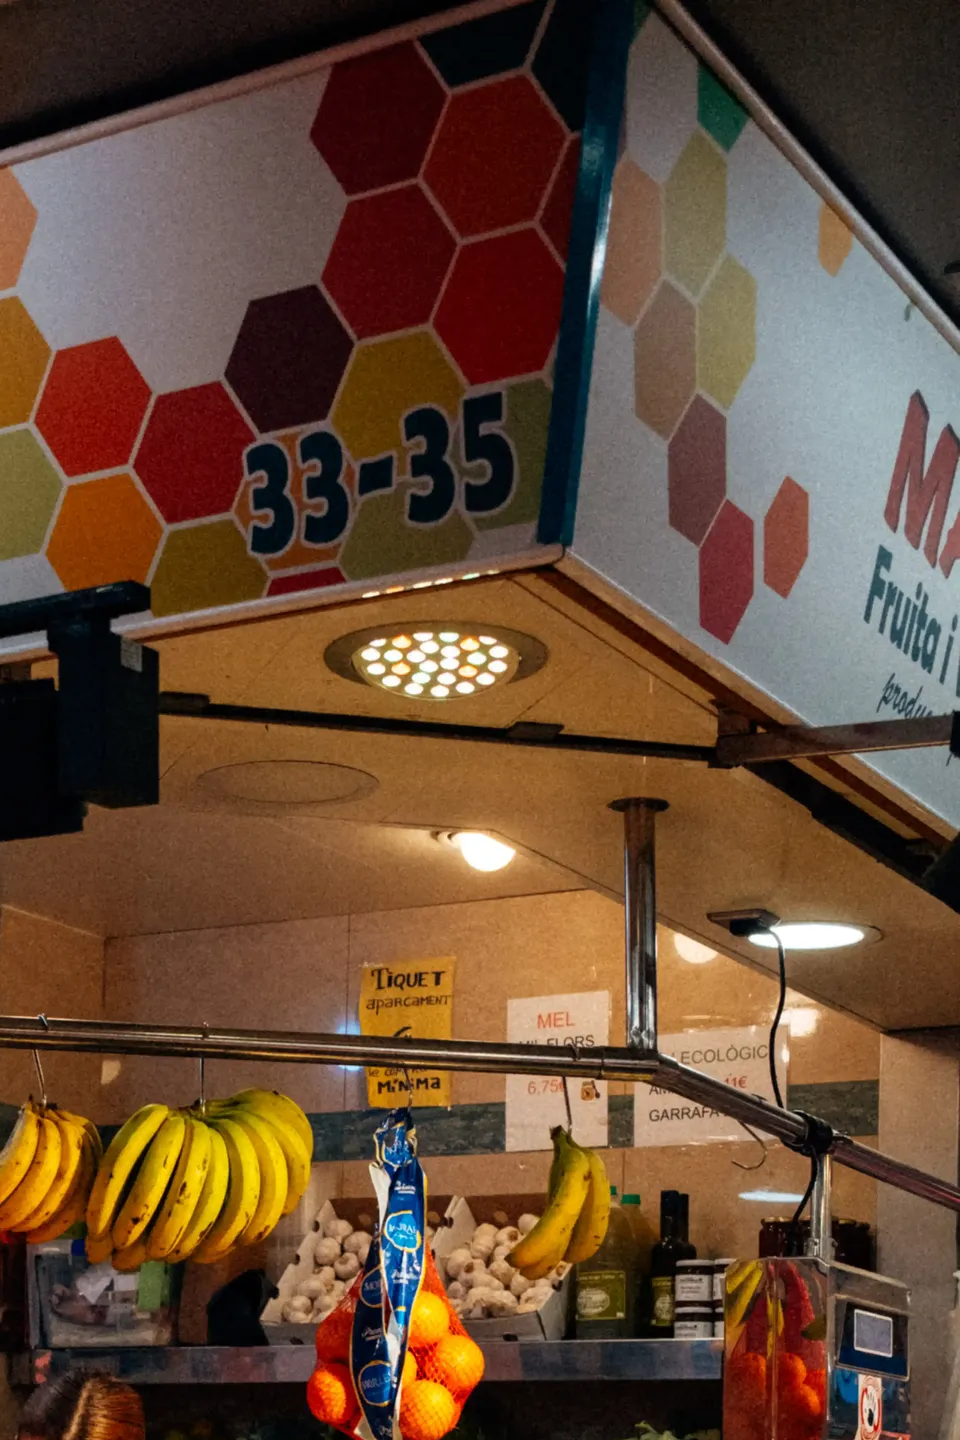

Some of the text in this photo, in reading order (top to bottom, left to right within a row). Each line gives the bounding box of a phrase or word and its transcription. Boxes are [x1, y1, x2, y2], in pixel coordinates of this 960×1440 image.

[244, 392, 516, 555] 33-35
[863, 544, 959, 685] Fruita i
[537, 1011, 576, 1029] MEL
[680, 1044, 769, 1065] ECOLÒGIC
[648, 1106, 720, 1122] GARRAFA
